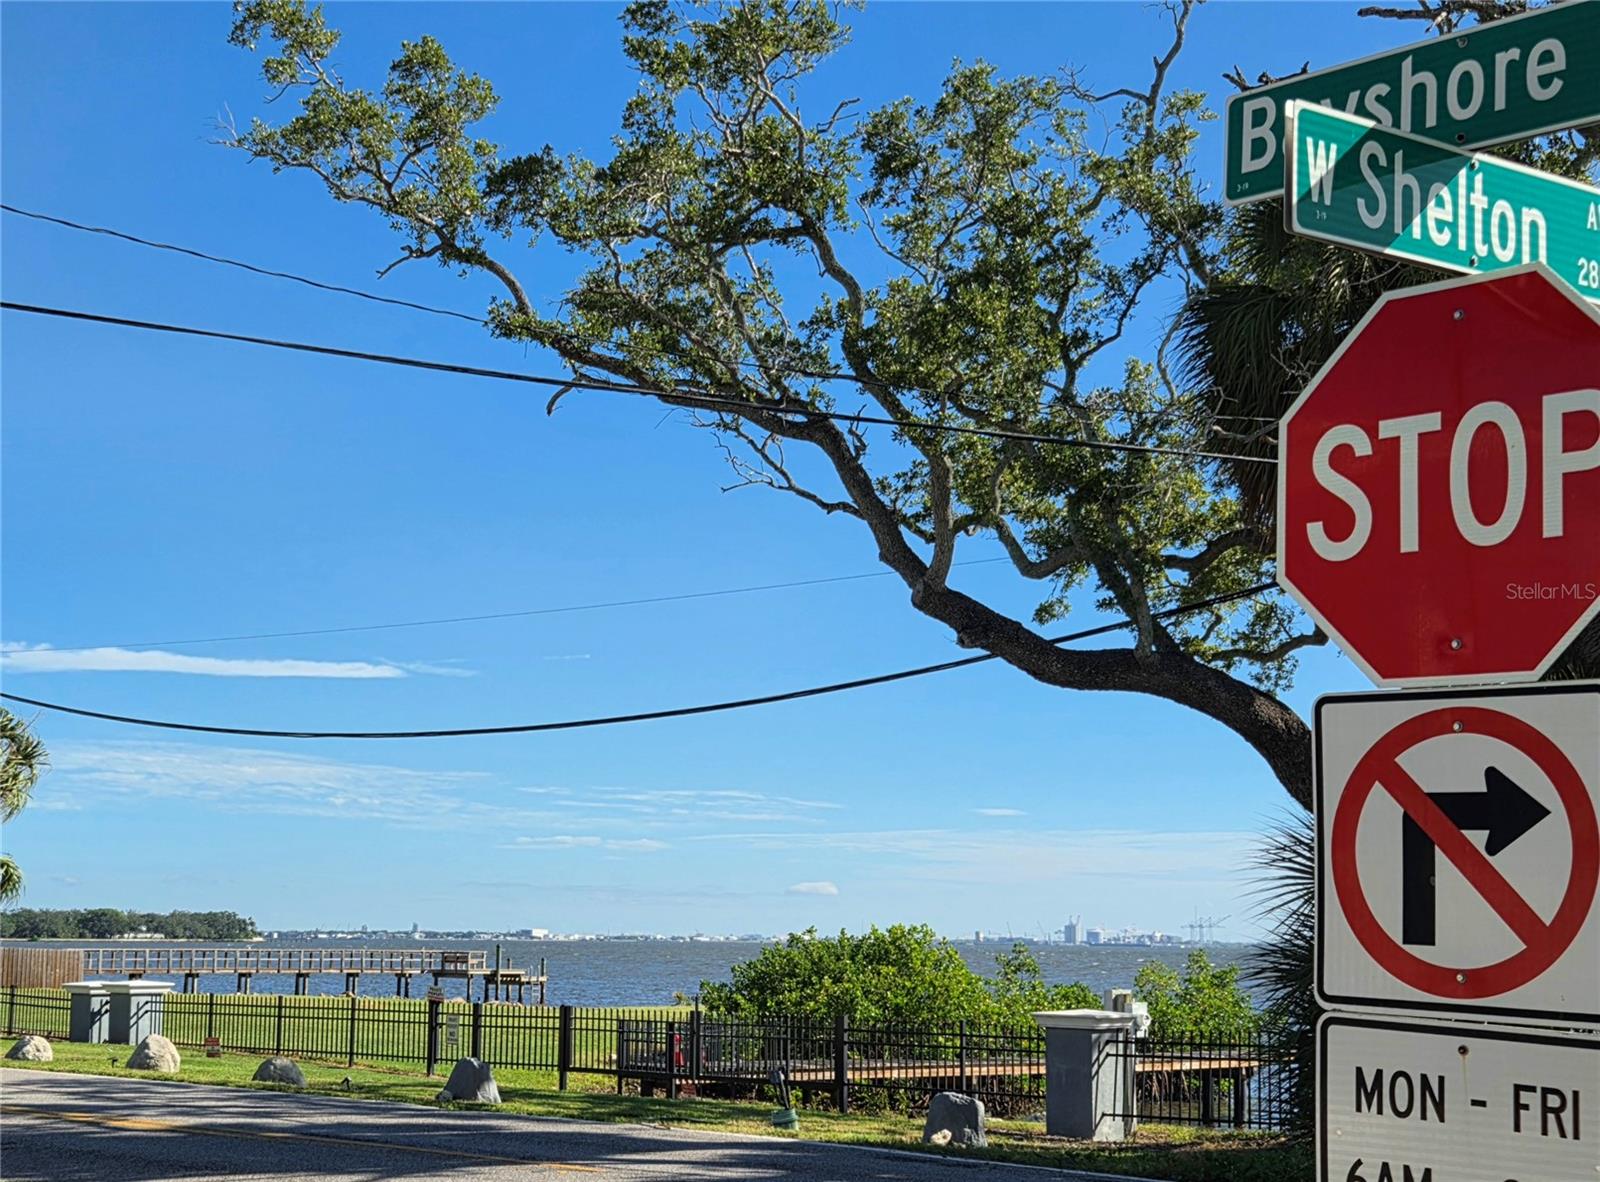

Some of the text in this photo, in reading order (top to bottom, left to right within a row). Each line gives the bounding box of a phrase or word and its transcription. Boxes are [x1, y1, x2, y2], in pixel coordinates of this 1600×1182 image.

[1241, 38, 1567, 175] Bshore
[1306, 136, 1547, 264] W Shelton
[1586, 201, 1600, 231] A
[1306, 389, 1600, 562] STOP
[1355, 1066, 1445, 1123] MON
[1513, 1083, 1580, 1141] FRI
